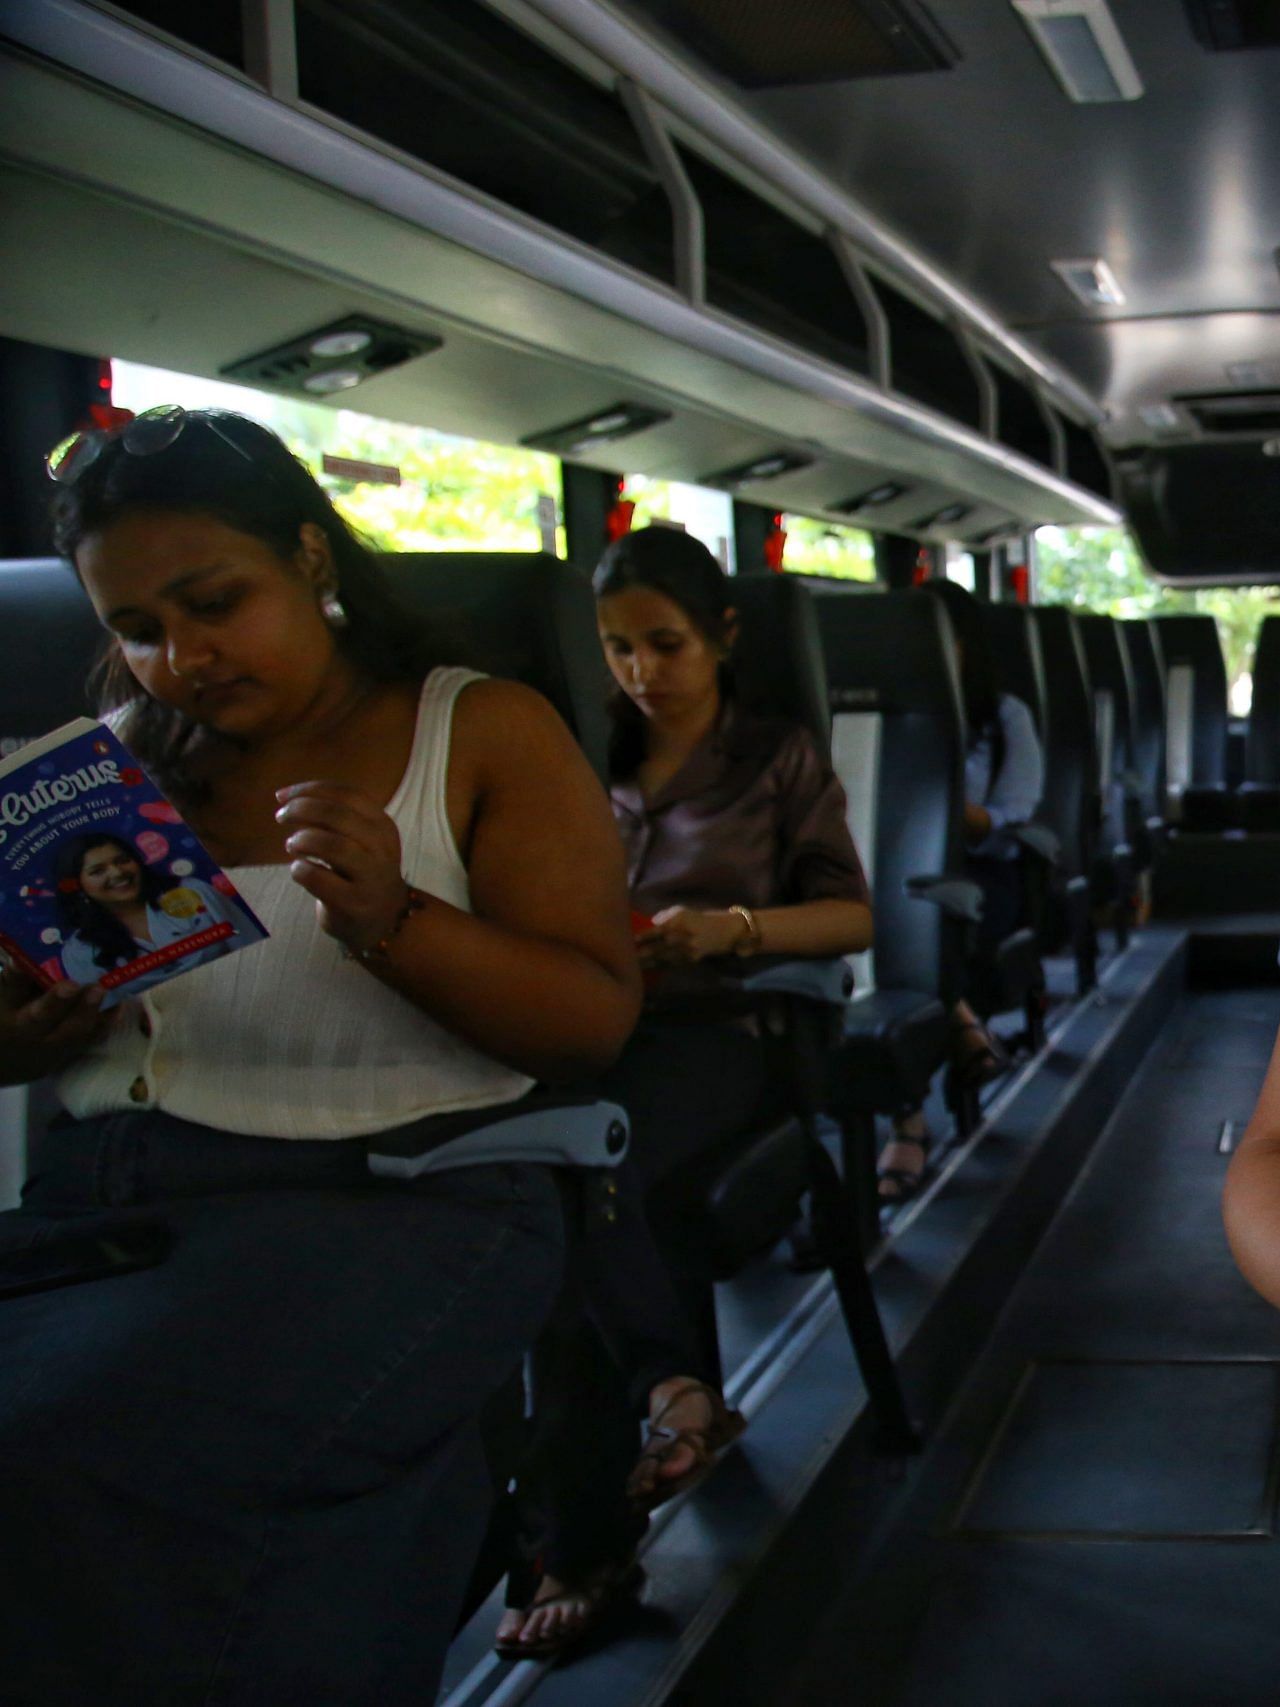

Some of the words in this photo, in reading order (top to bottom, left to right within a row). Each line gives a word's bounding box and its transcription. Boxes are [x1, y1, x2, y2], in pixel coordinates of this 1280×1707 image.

[47, 806, 82, 825] NOBODY
[84, 797, 112, 810] TELLS
[11, 853, 30, 871] YOU
[29, 828, 60, 854] ABOUT
[61, 815, 90, 832] YOUR
[91, 806, 121, 821] BODY
